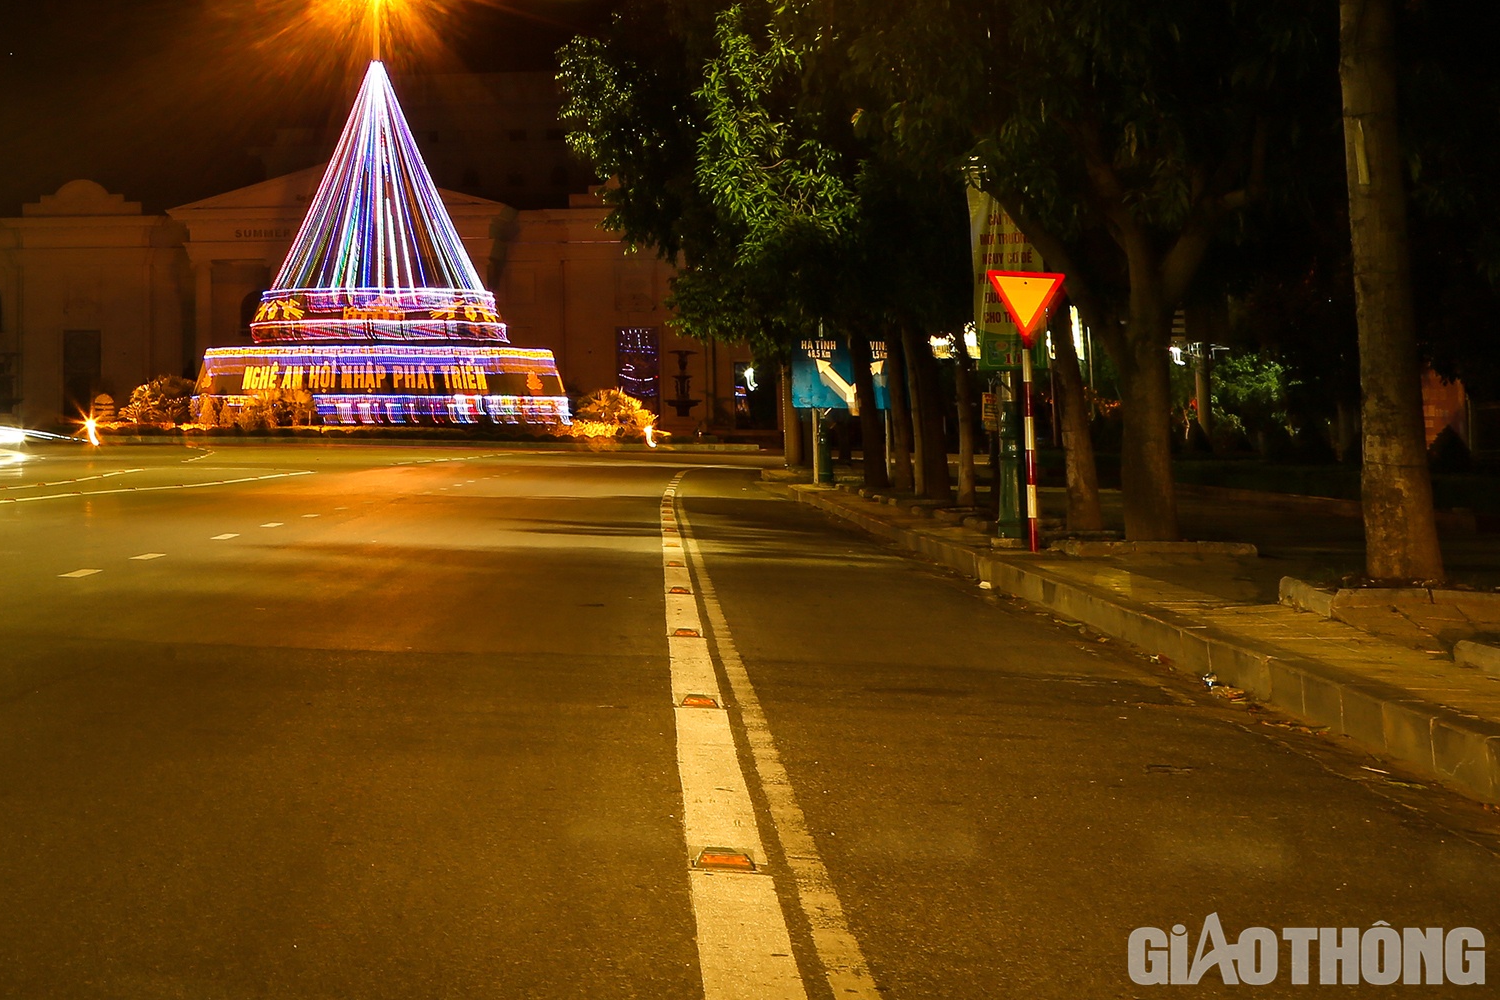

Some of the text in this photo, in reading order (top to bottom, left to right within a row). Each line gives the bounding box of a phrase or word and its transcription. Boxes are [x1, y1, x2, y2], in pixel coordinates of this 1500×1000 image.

[235, 229, 291, 239] SUMMER
[280, 365, 304, 390] AN
[308, 360, 337, 393] HỘI
[341, 360, 386, 393] NHẬP
[393, 360, 435, 389] PHÁT
[440, 358, 488, 390] TRIỂN
